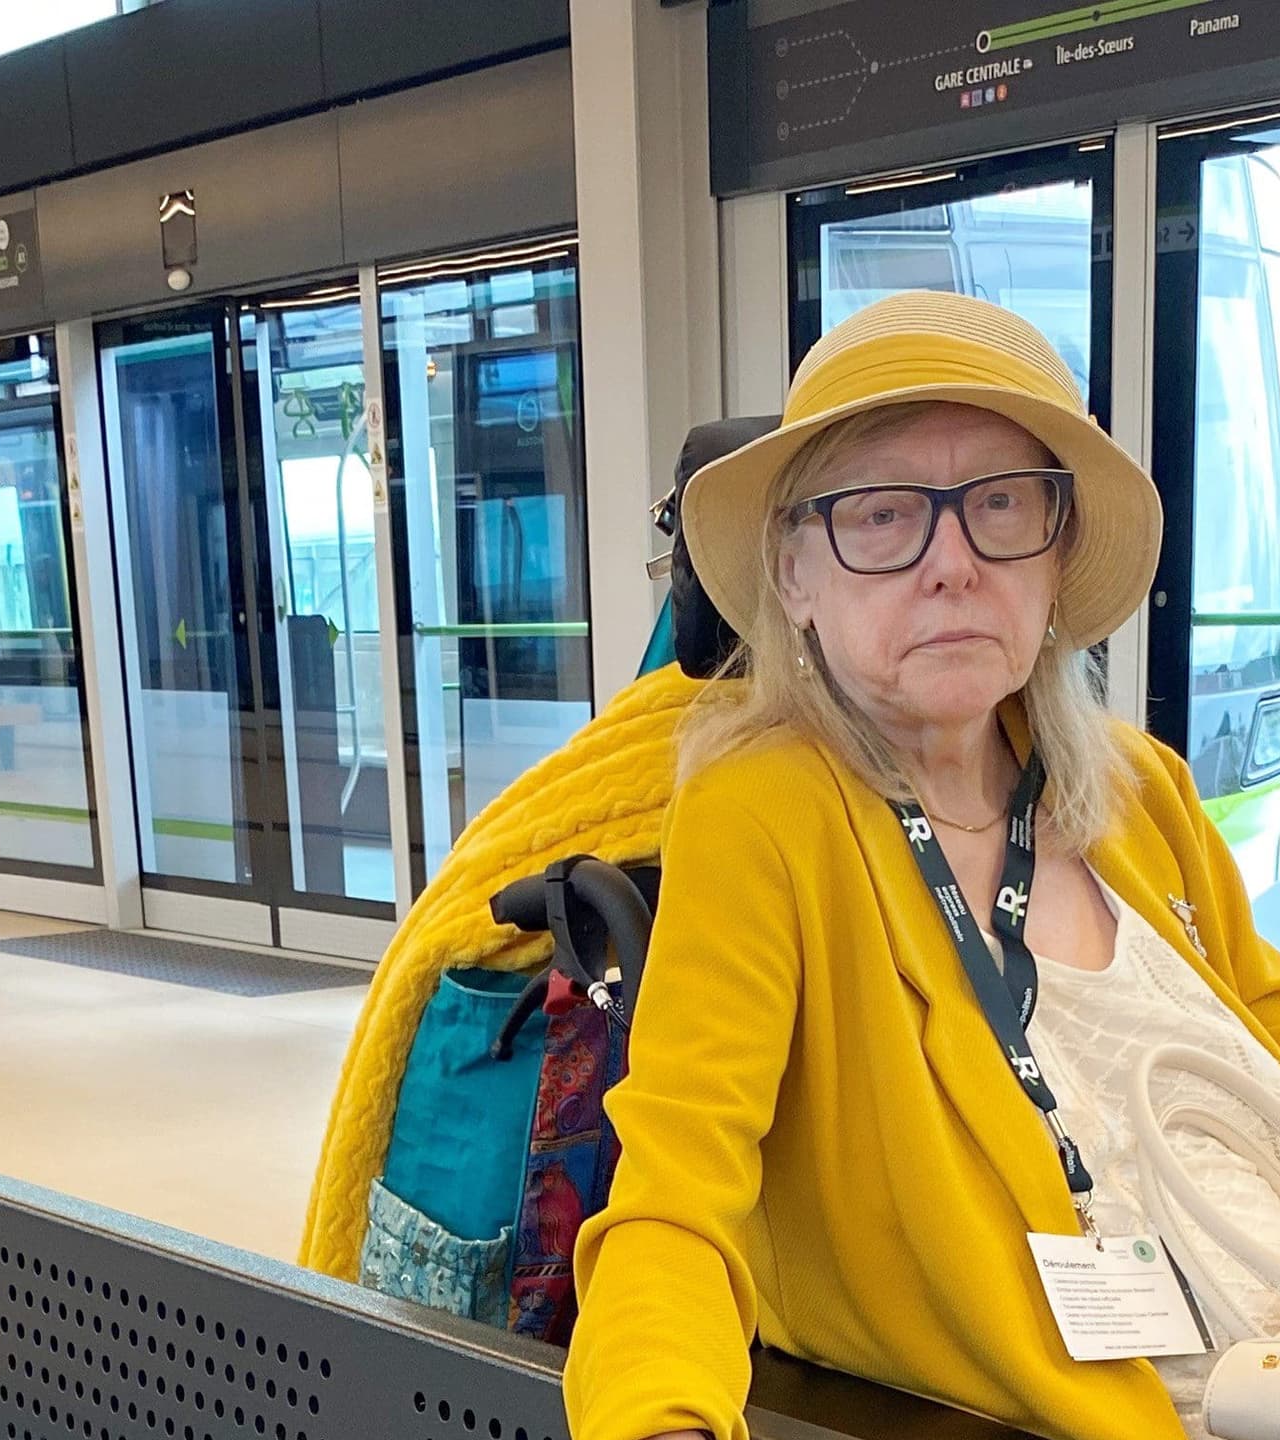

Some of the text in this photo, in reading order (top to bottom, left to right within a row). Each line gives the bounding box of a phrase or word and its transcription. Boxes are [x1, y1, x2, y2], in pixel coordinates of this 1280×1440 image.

[1190, 14, 1239, 37] Panama
[935, 58, 1021, 92] GARE CENTRALE
